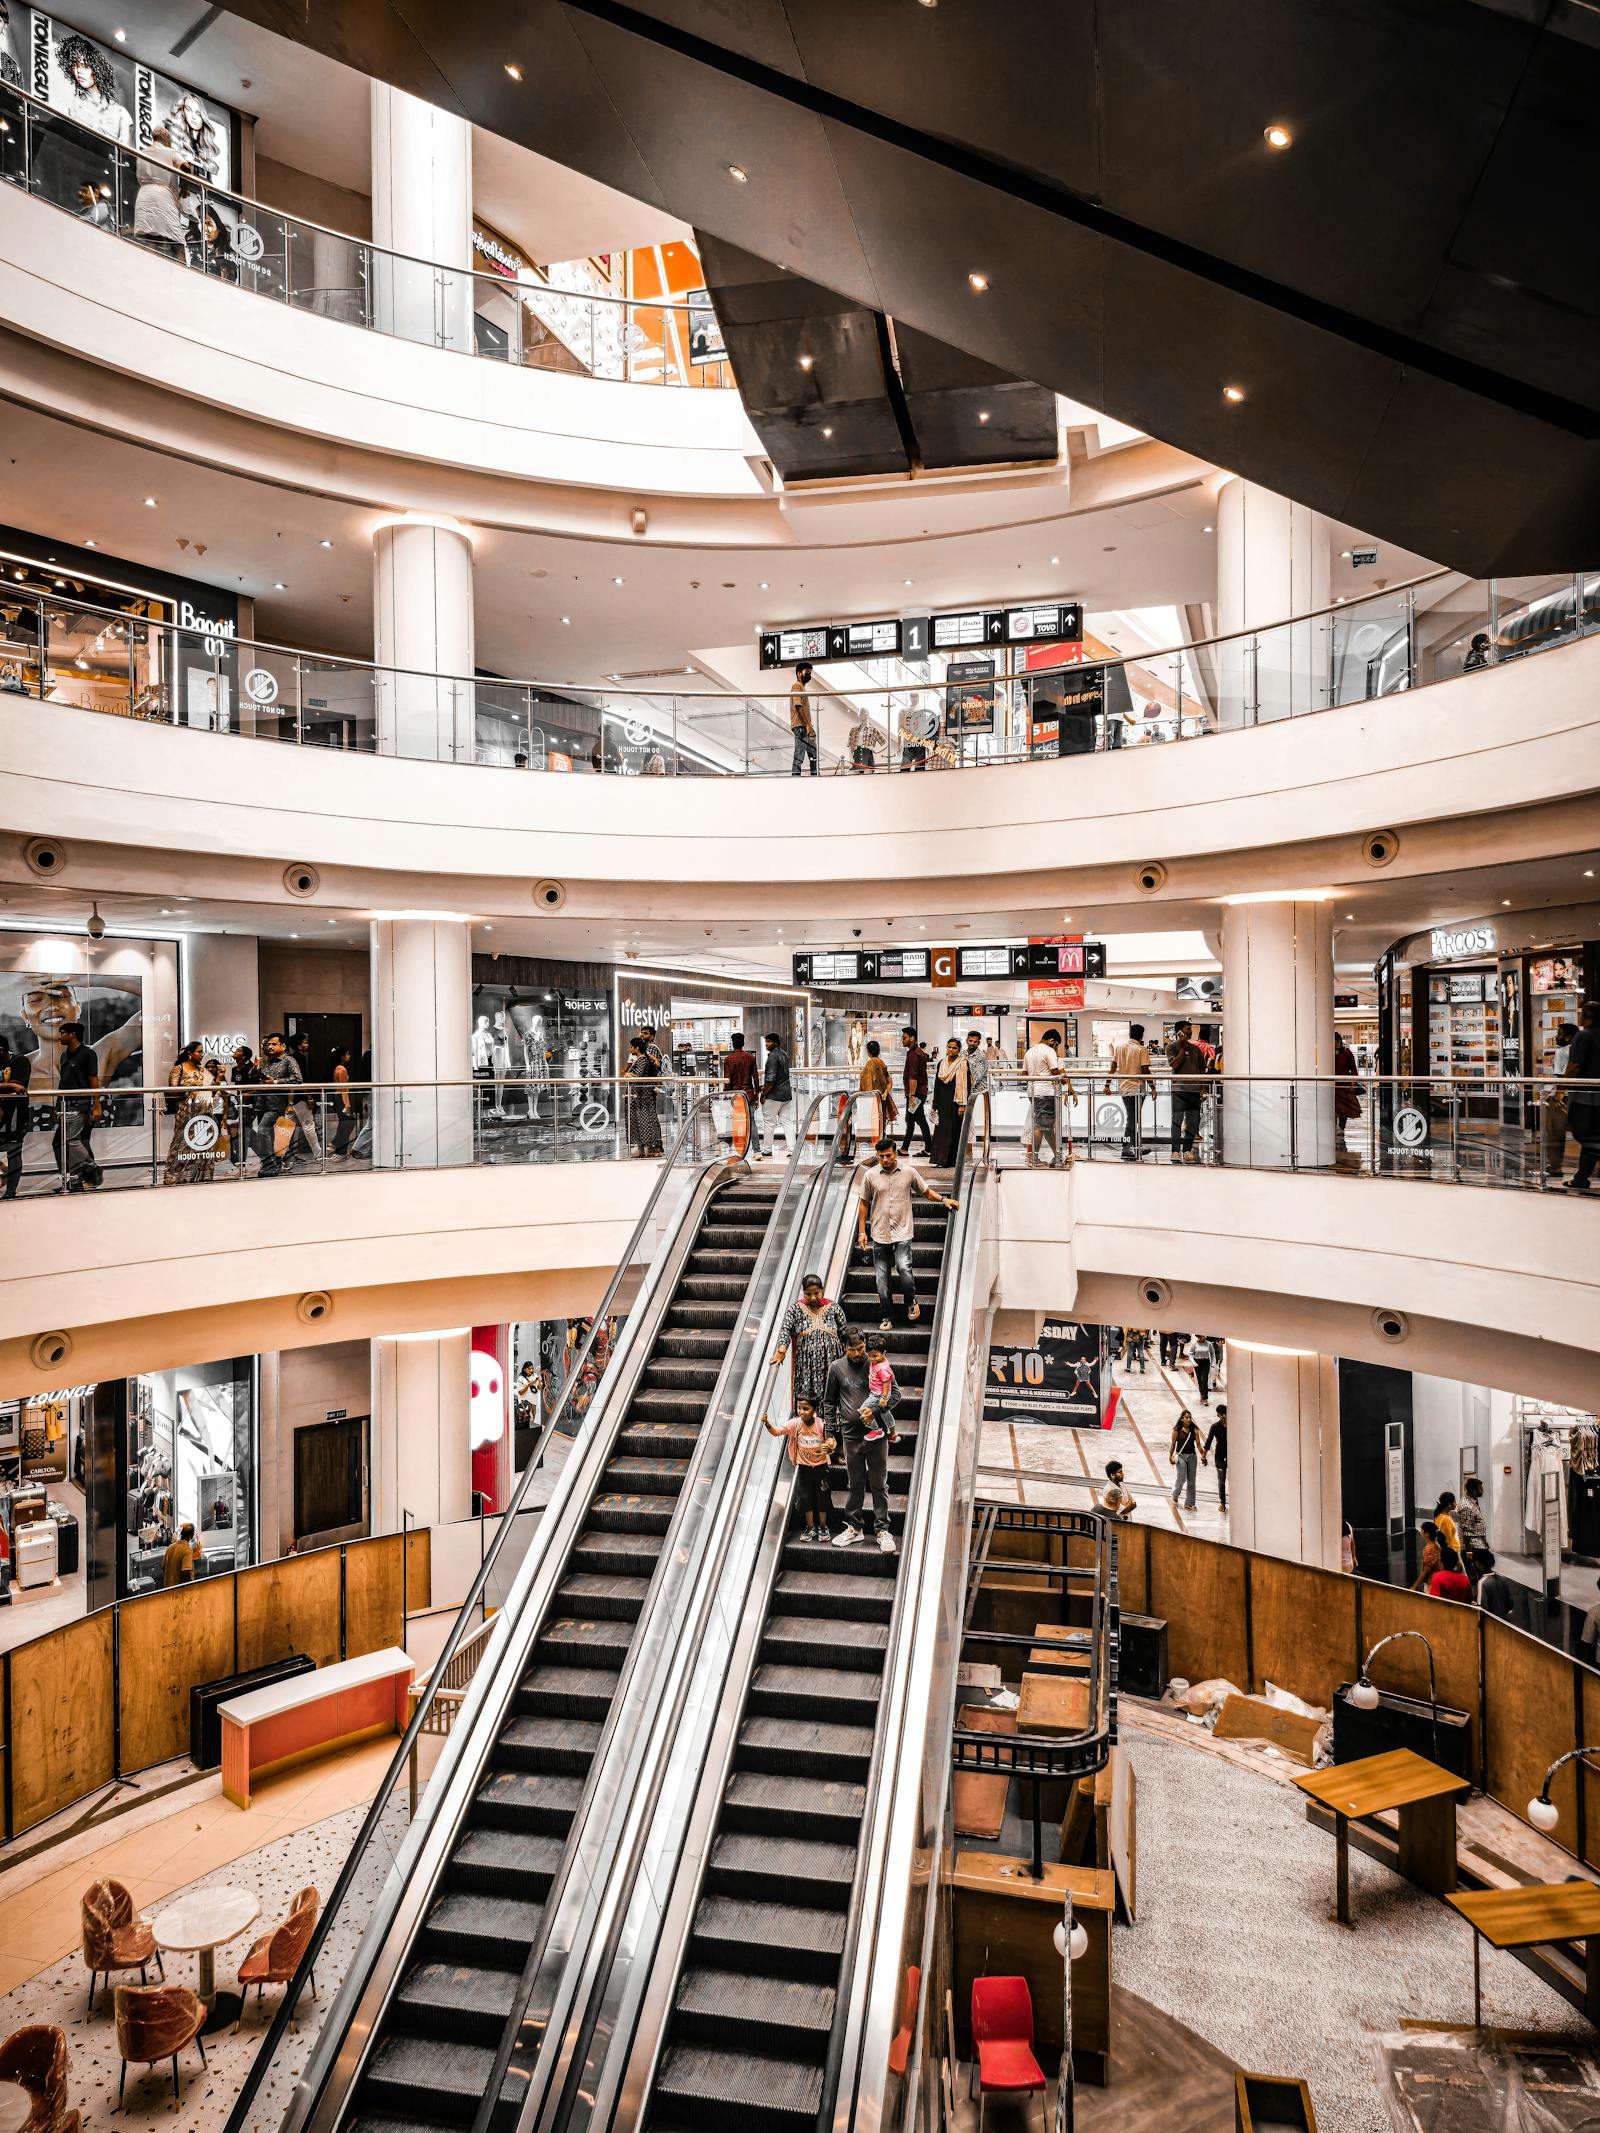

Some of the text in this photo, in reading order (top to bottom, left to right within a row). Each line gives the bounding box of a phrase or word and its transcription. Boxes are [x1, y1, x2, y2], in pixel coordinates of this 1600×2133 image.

[33, 14, 50, 102] TONI&GU
[138, 69, 153, 151] TONI&GU
[909, 626, 922, 650] 1
[1431, 930, 1487, 957] PARCOS
[934, 956, 951, 976] G
[621, 999, 671, 1031] lifestyle
[26, 1384, 97, 1406] LOUNGE
